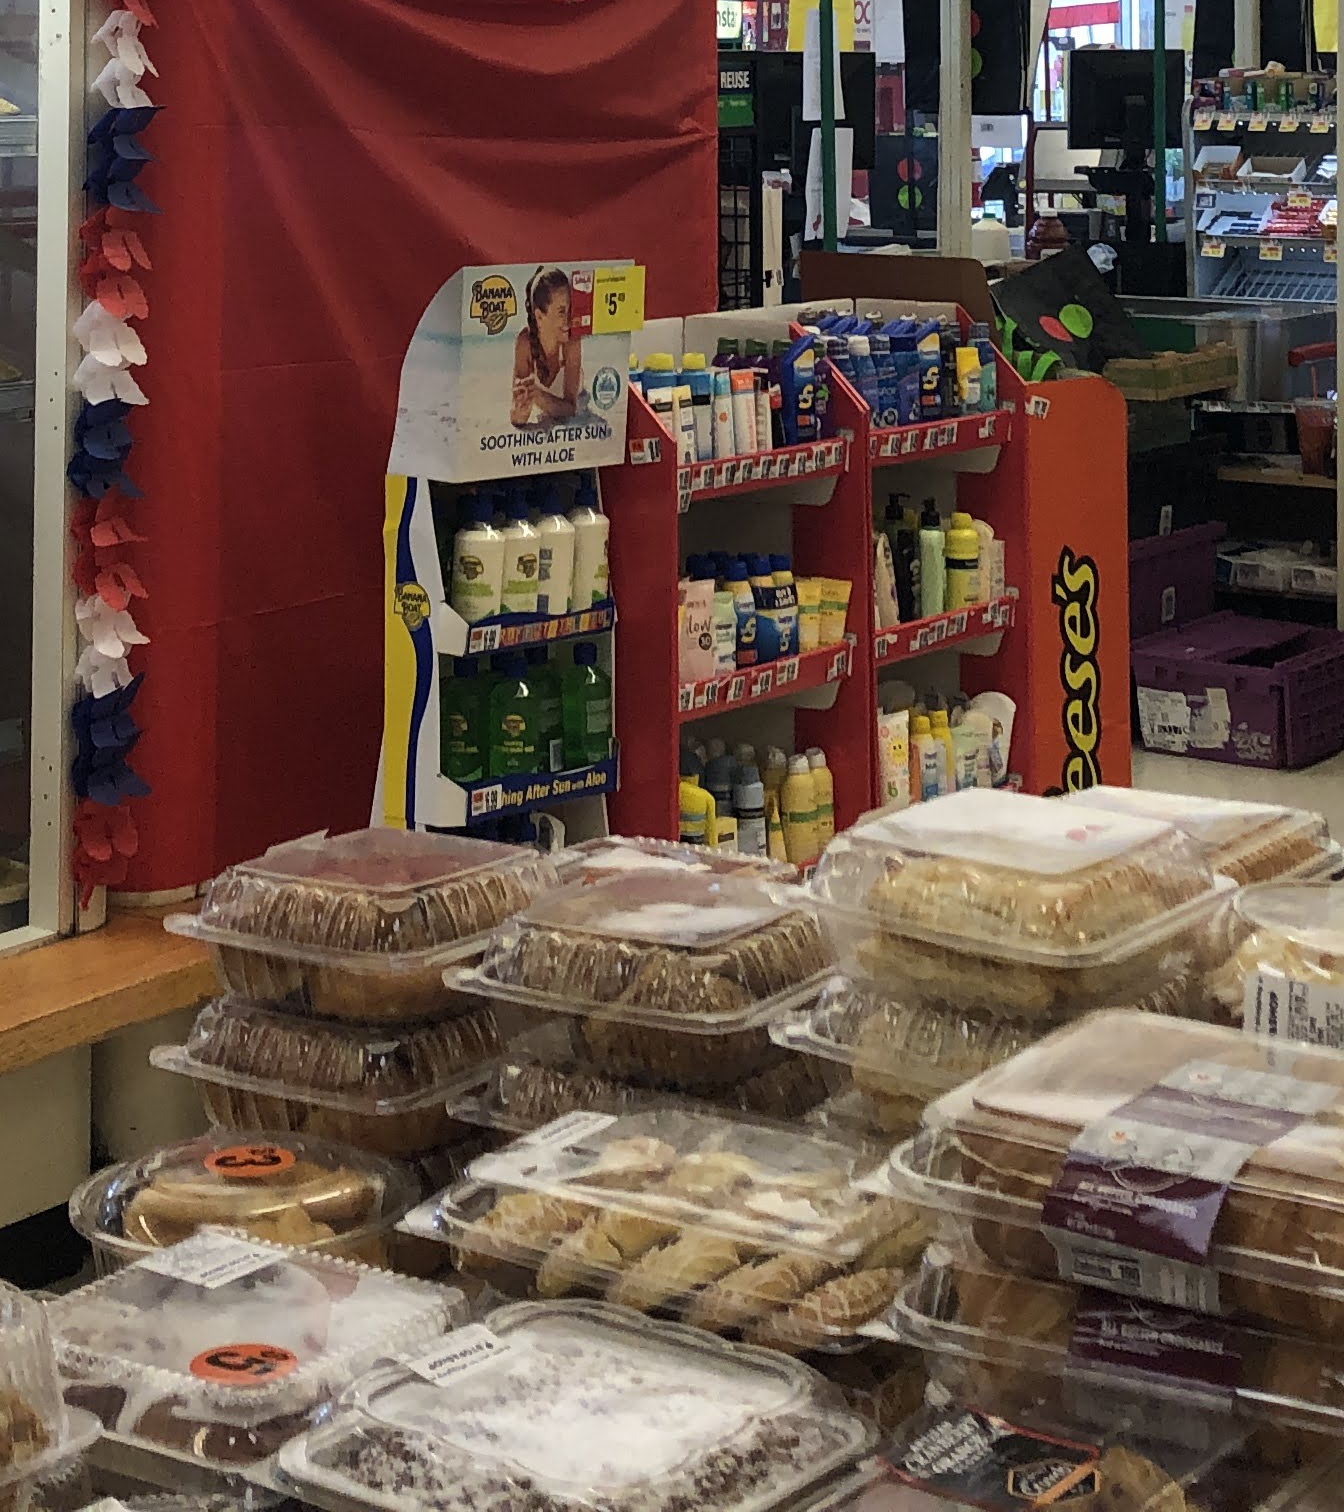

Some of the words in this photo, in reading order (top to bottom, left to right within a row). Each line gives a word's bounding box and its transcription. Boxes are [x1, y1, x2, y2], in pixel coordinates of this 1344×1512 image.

[720, 70, 750, 89] REUSE
[474, 287, 513, 303] BANANA
[480, 300, 506, 319] BOAT
[479, 430, 544, 451] SOOTHING
[546, 427, 582, 444] AFTER
[511, 453, 542, 468] WITH
[545, 447, 576, 465] ALOE
[1052, 548, 1100, 795] eese's
[526, 781, 551, 801] After
[552, 779, 571, 797] Sun
[585, 771, 607, 788] Aloe
